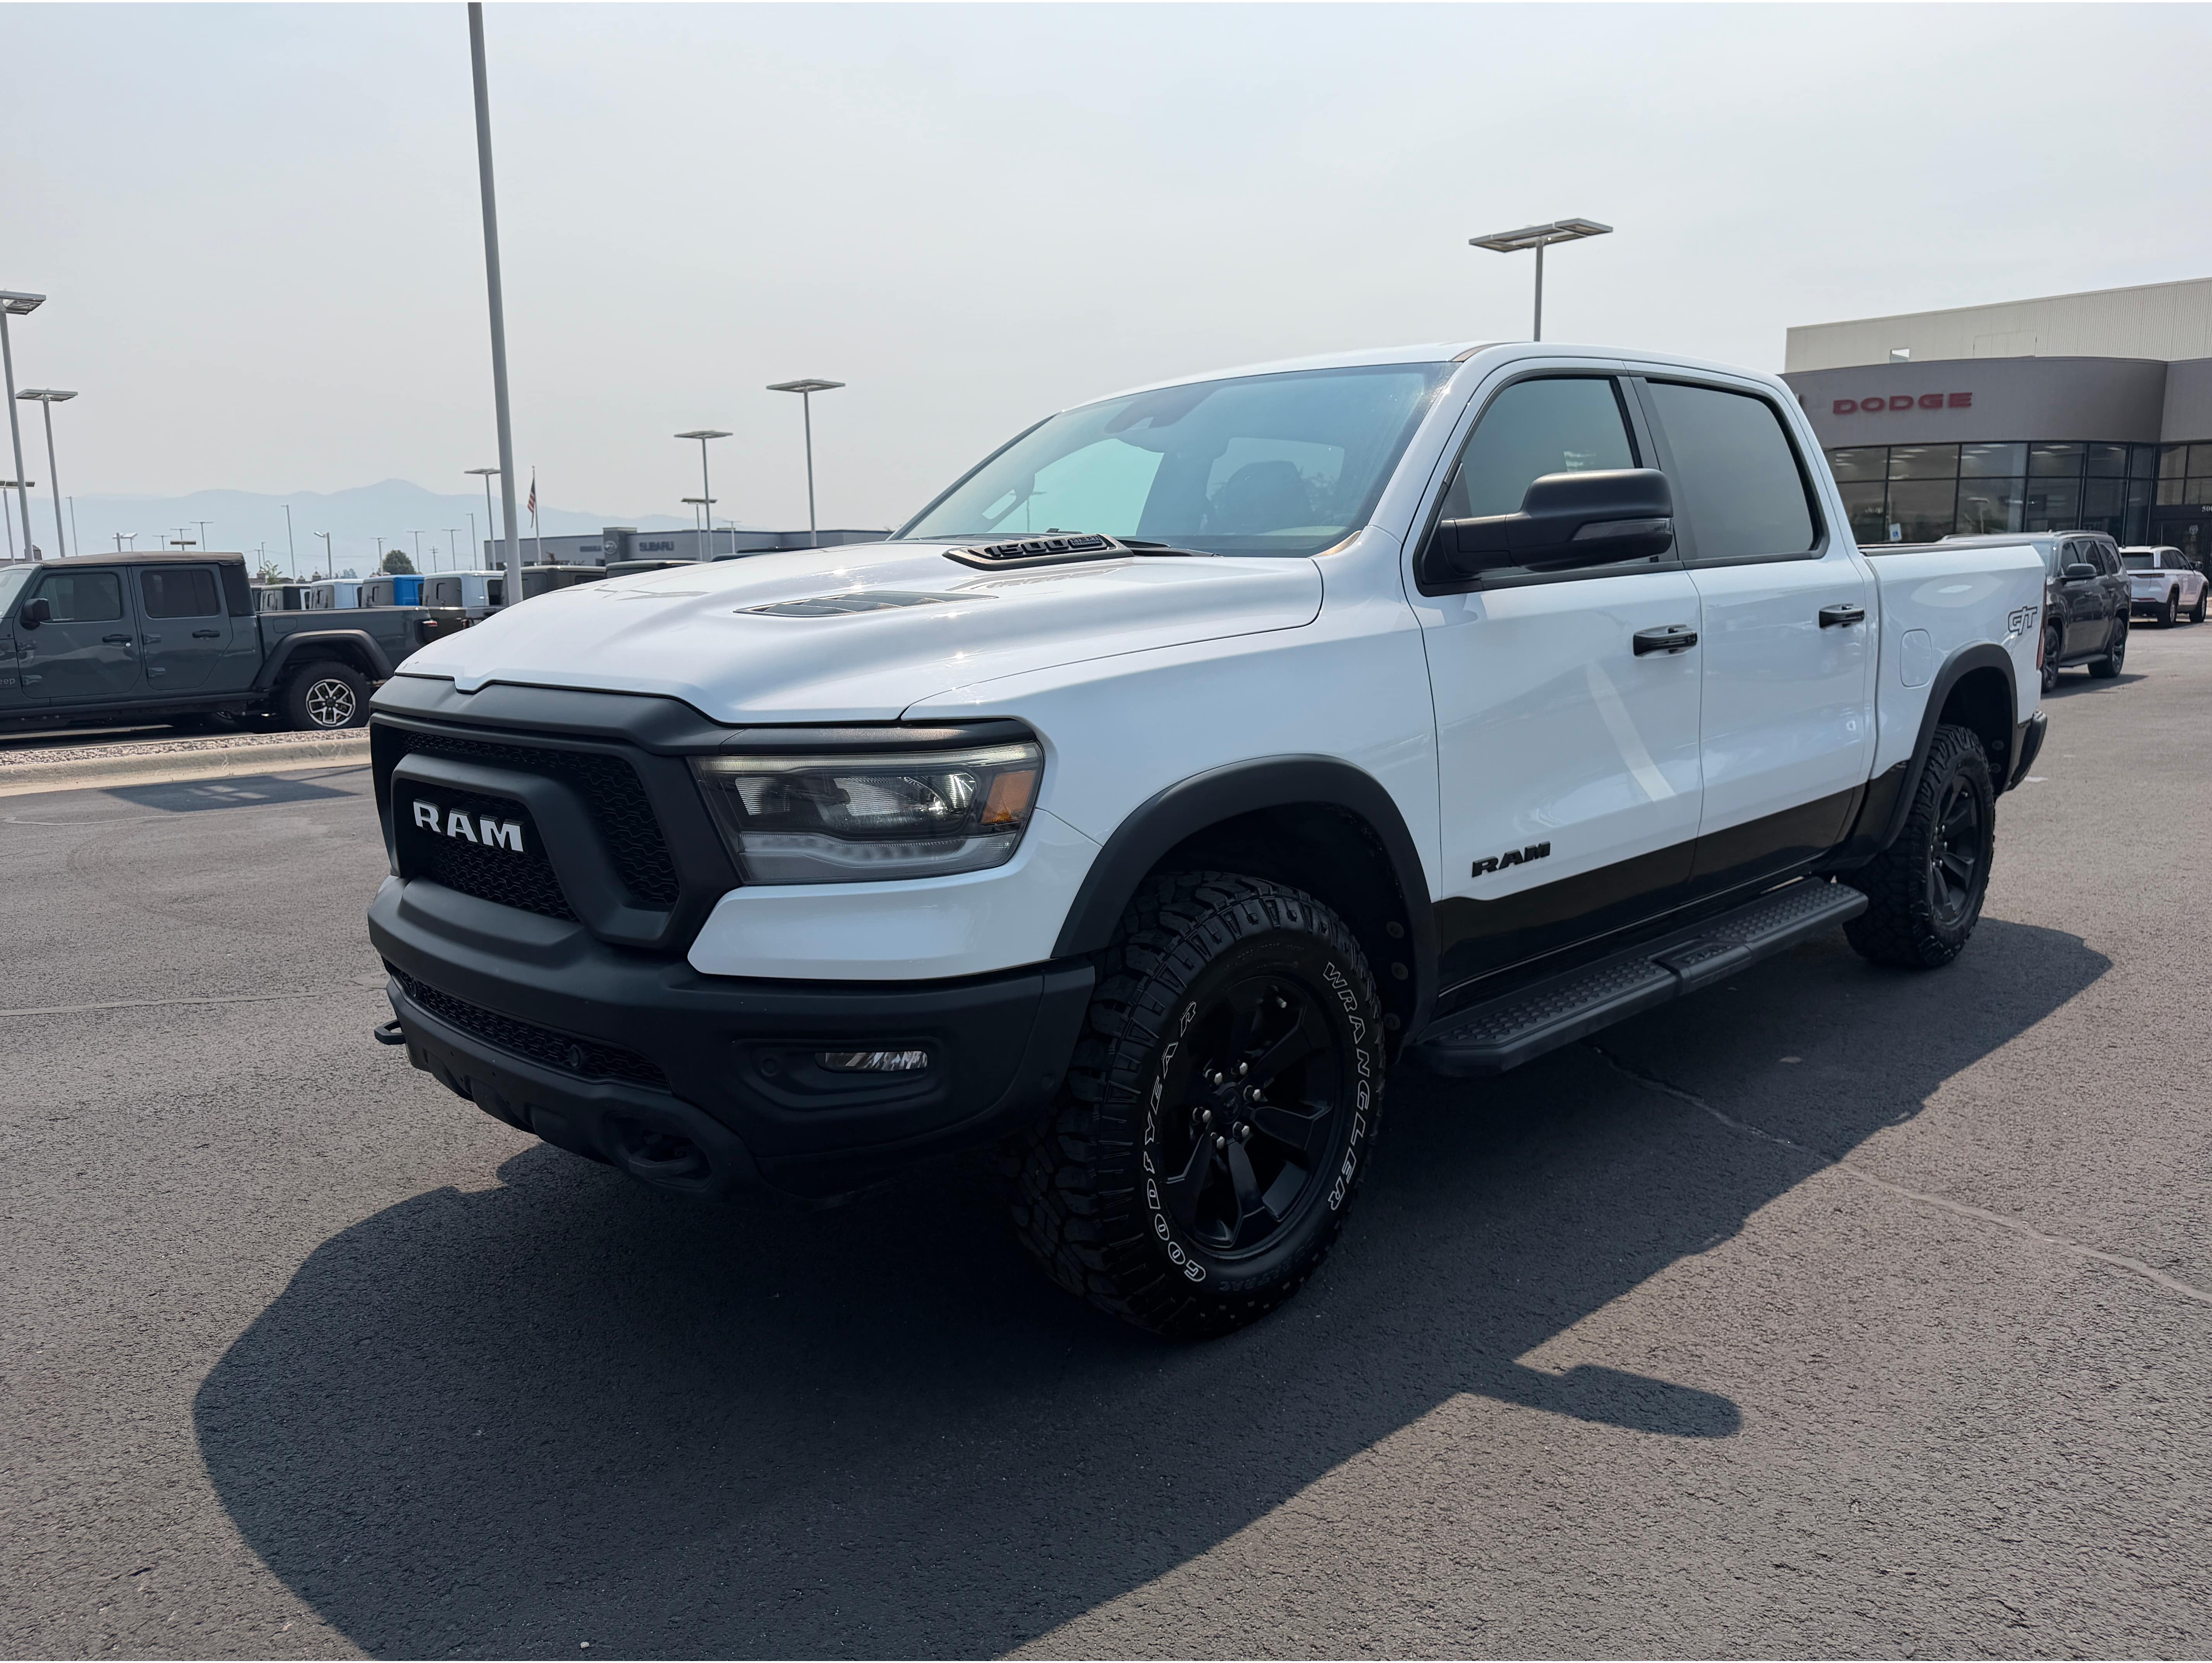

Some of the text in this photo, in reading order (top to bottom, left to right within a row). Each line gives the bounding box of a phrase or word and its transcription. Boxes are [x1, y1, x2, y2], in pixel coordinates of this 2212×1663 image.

[1832, 392, 1973, 415] DODGE
[639, 541, 674, 551] SUBARU
[985, 539, 1069, 557] 1500
[413, 798, 526, 852] RAM
[1472, 841, 1551, 878] RAM
[1323, 961, 1370, 1211] WRANGLER
